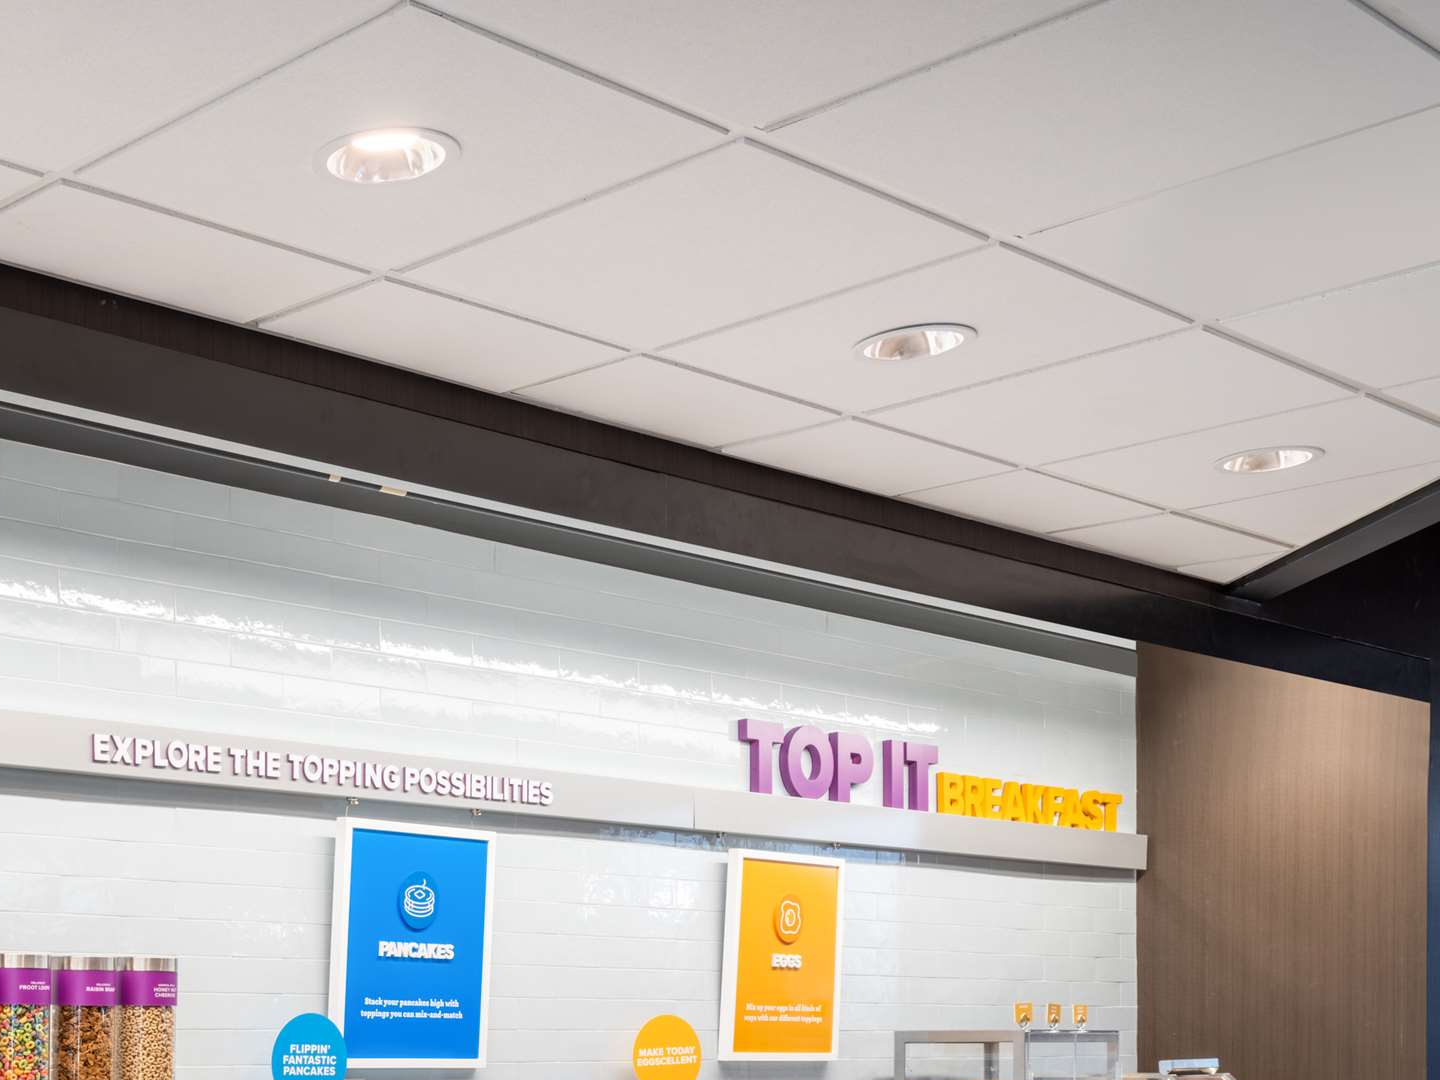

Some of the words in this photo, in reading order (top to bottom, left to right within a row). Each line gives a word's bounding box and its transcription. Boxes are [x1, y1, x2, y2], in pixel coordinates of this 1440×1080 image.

[91, 733, 223, 775] EXPLORE
[228, 746, 281, 781] THE
[286, 753, 400, 793] TOPPING
[403, 766, 554, 806] POSSIBILITIES
[737, 718, 874, 802] TOP
[882, 739, 938, 812] IT
[935, 771, 1122, 833] BREAKFAST
[378, 940, 455, 961] PANCAKES
[770, 953, 802, 969] EGGS
[290, 1044, 331, 1054] FLIPPIN'
[639, 1047, 664, 1057] MAKE
[666, 1046, 696, 1055] TODAY
[282, 1055, 337, 1065] FANTASTIC
[637, 1055, 698, 1067] EGGSCELLENT
[283, 1066, 336, 1076] PANCAKES
